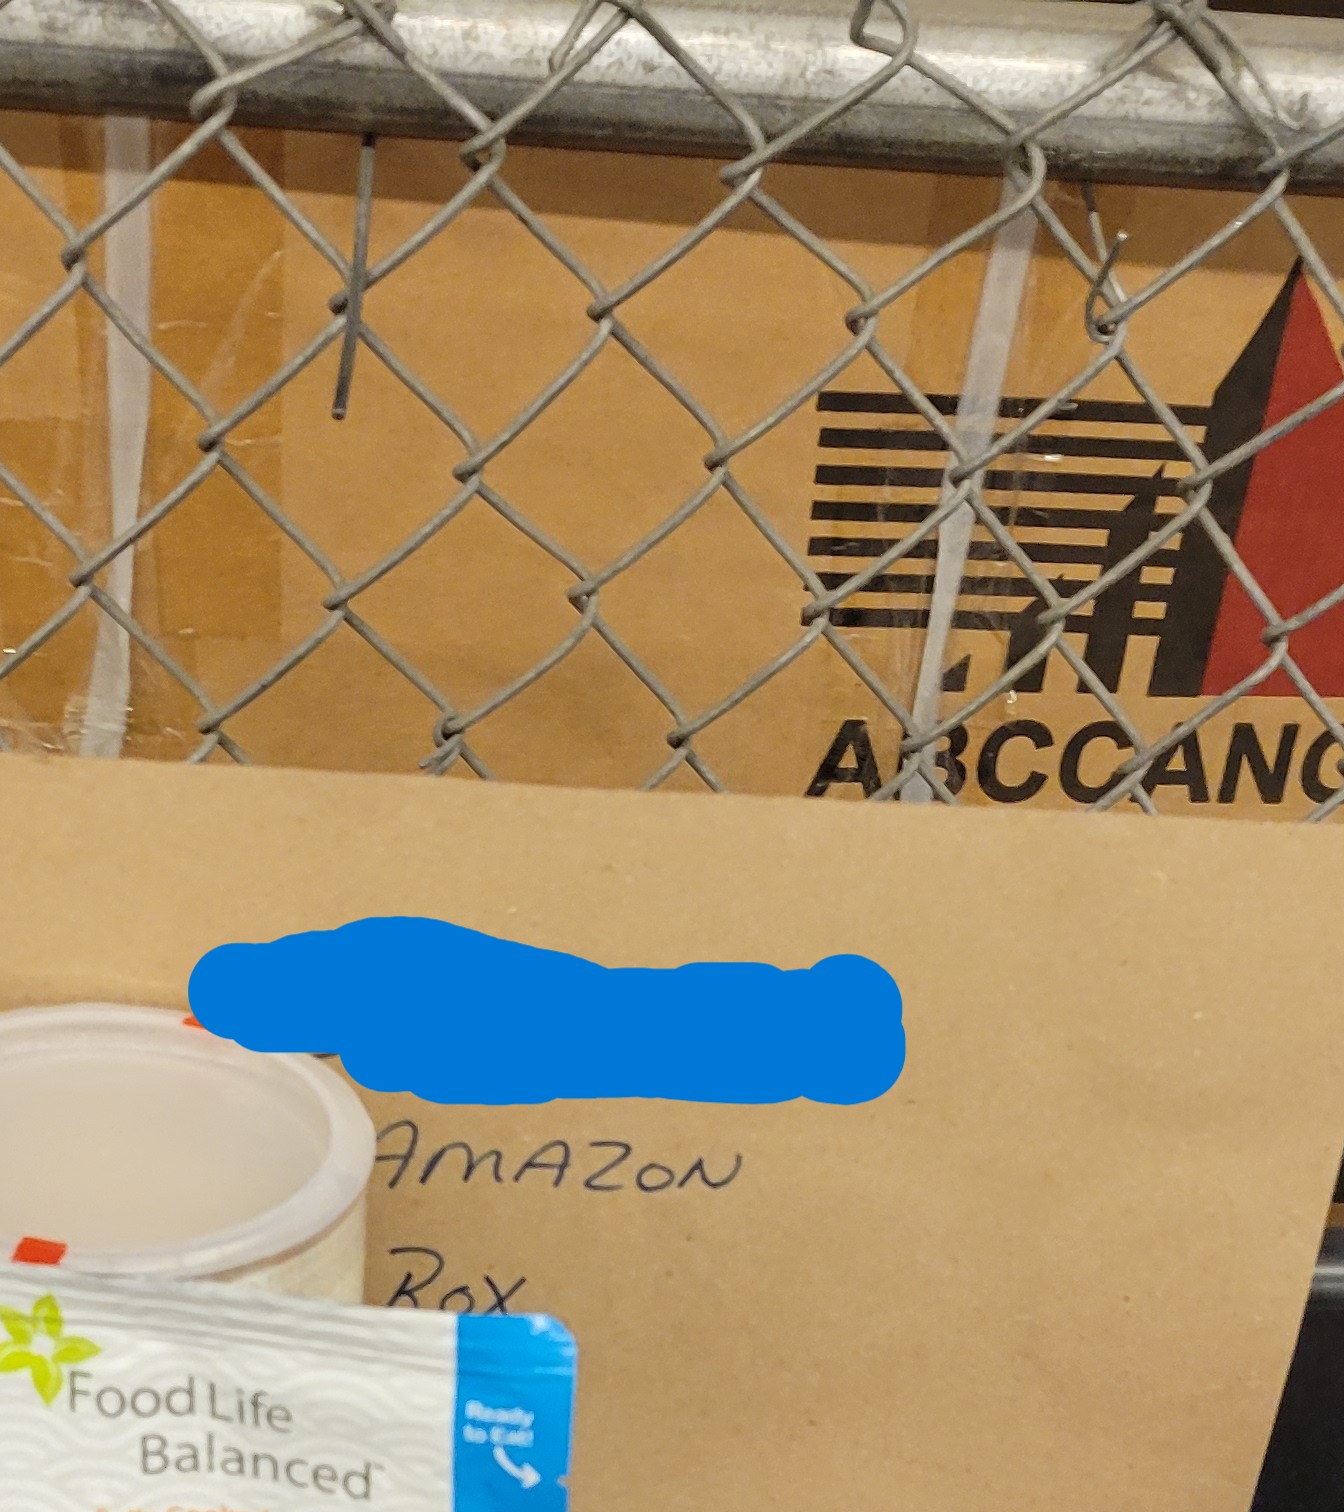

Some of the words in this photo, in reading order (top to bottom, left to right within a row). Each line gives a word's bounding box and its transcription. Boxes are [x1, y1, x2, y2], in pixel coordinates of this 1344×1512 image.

[373, 1118, 745, 1194] AMAZON
[67, 1367, 198, 1421] Food
[206, 1374, 295, 1436] Life
[139, 1431, 375, 1503] Balanced
